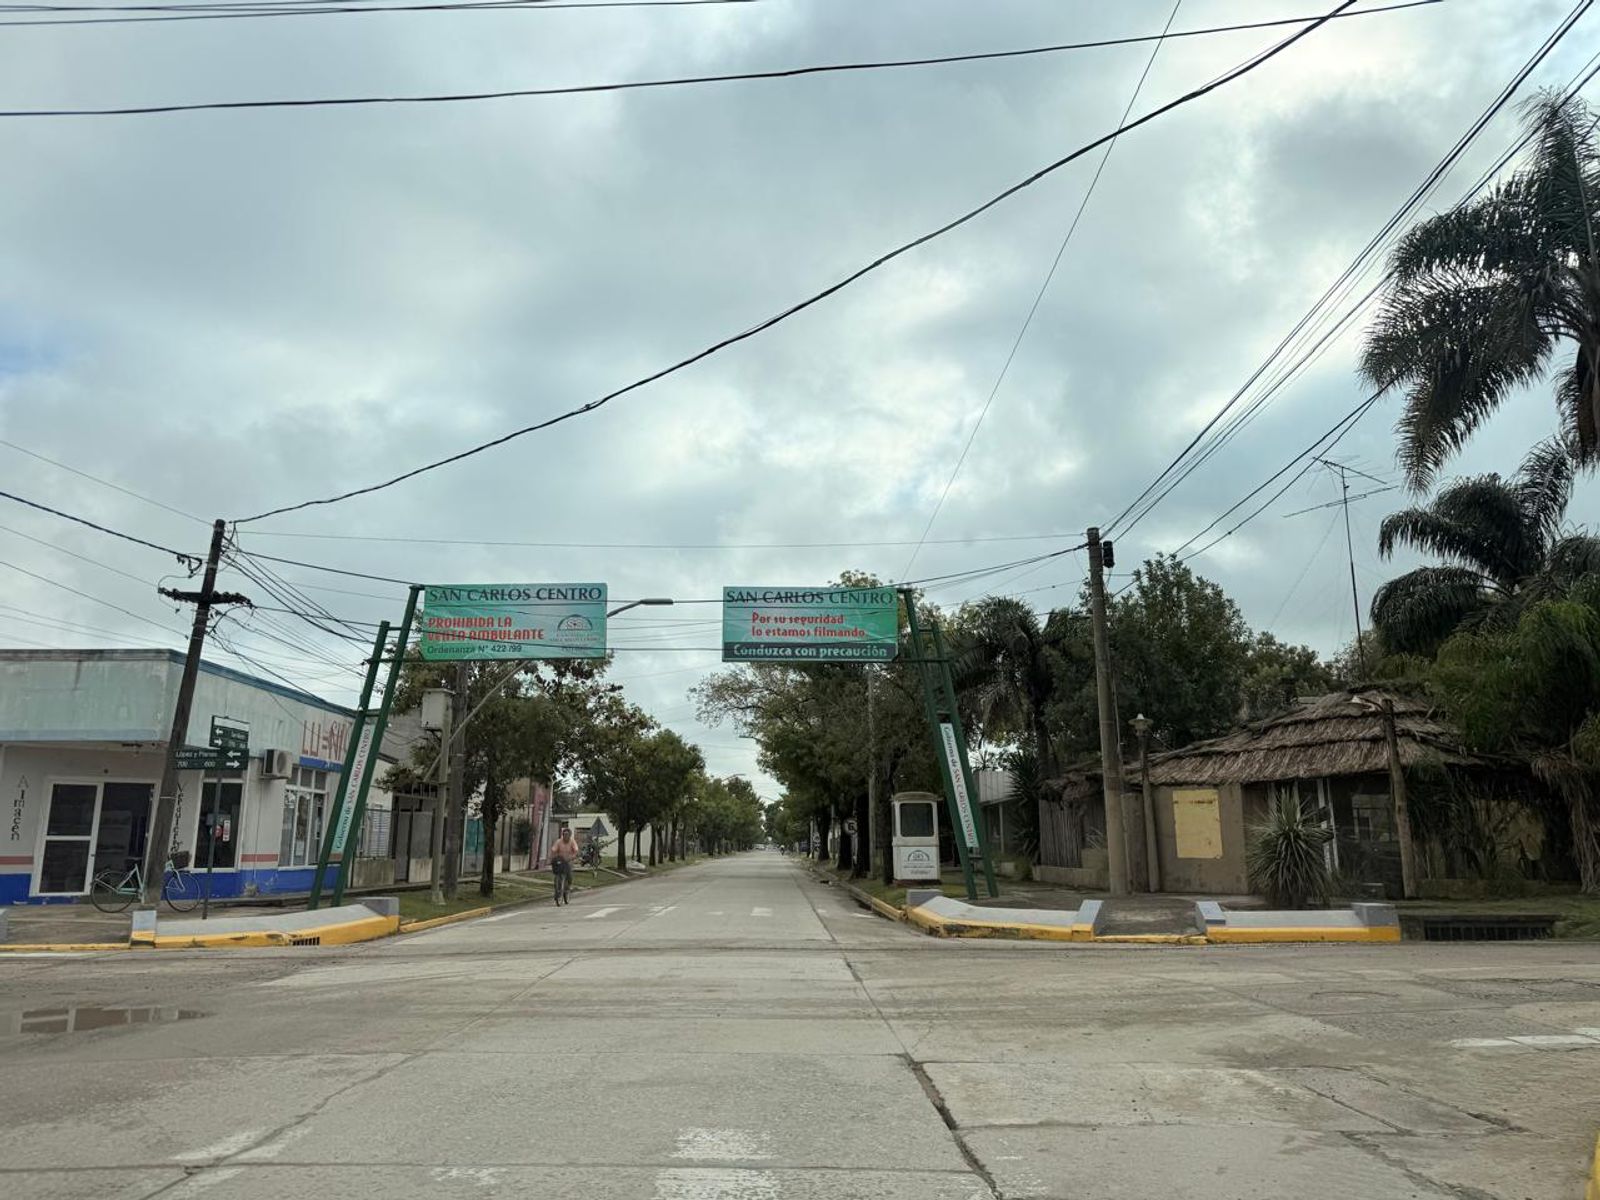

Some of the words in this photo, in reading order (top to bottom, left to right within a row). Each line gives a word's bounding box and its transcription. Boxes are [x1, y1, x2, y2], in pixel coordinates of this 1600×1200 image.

[429, 589, 461, 601] SAN
[467, 588, 531, 600] CARLOS
[536, 587, 602, 600] CENTRO
[727, 591, 757, 603] SAN
[762, 591, 824, 603] CARLOS
[829, 591, 893, 604] CENTRO
[428, 616, 494, 628] PROHIBIDA
[498, 616, 512, 627] LA
[752, 612, 771, 624] Por
[774, 615, 786, 624] su
[788, 614, 844, 626] seguridad
[428, 630, 466, 641] VENTA
[470, 629, 544, 640] AMBULANTE
[752, 627, 762, 637] lo
[765, 628, 810, 637] estamos
[814, 627, 865, 637] filmando
[427, 645, 475, 654] Ordenanza
[733, 644, 792, 657] Conduzca
[795, 646, 817, 657] con
[819, 645, 887, 658] precaución
[351, 760, 364, 788] CARLOS
[358, 729, 372, 758] CENTRO
[953, 768, 962, 783] SAN
